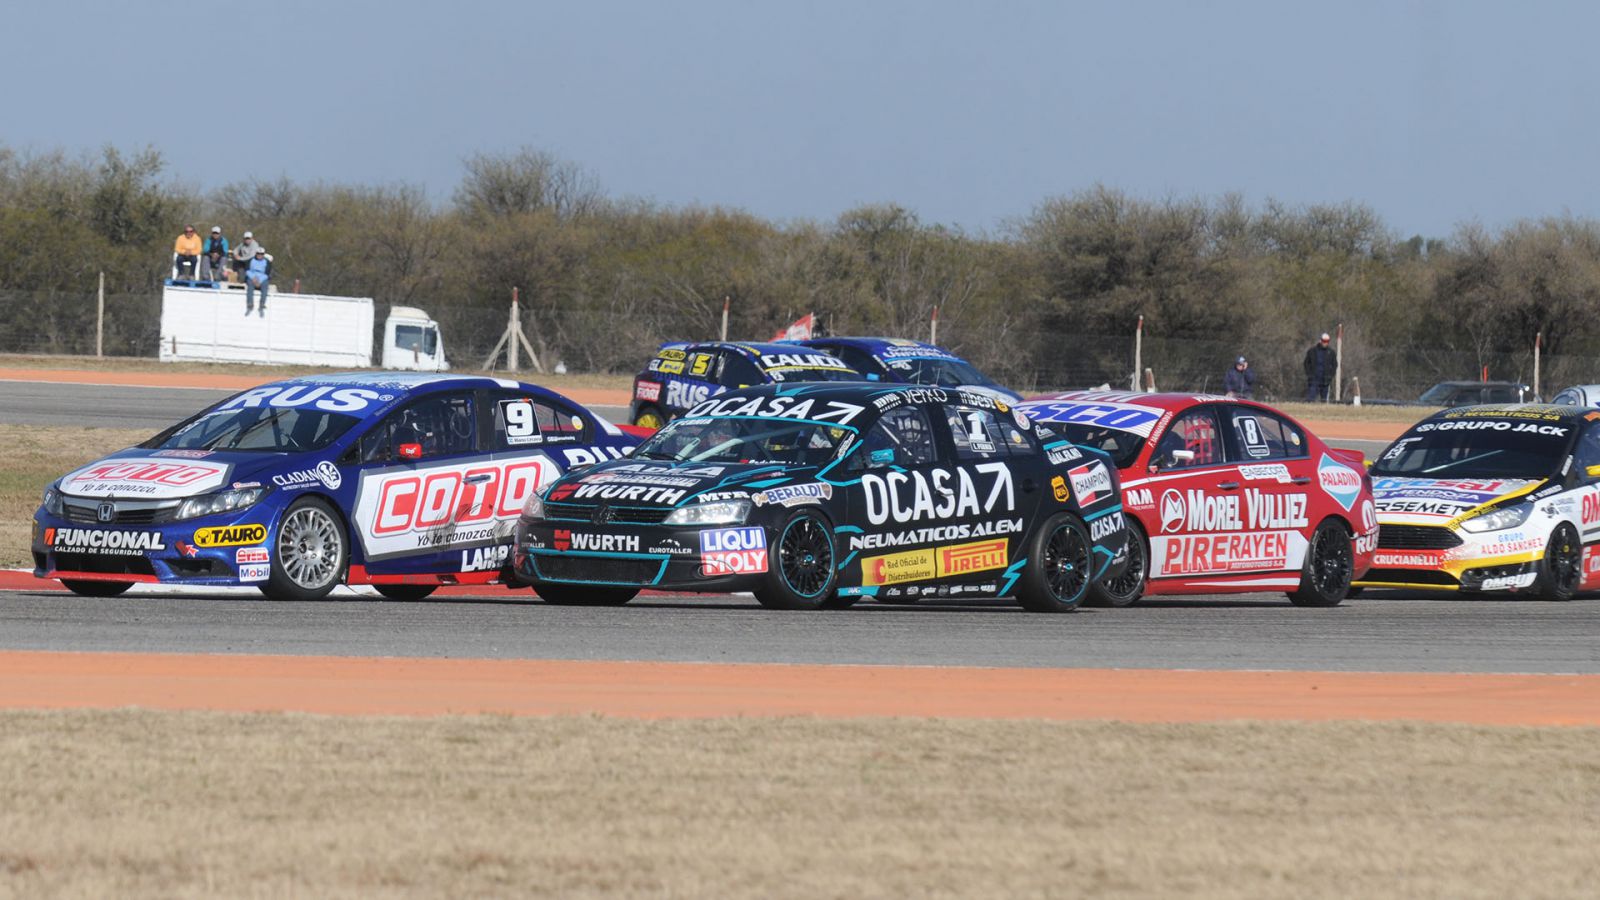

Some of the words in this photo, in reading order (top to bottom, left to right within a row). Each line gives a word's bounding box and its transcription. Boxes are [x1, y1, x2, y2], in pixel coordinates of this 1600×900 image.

[692, 354, 710, 374] 5
[761, 354, 847, 369] CALICO
[218, 386, 379, 411] RUS
[666, 380, 709, 409] RUS
[506, 402, 534, 436] 9
[967, 412, 986, 442] 1
[1440, 421, 1511, 431] GRUPO
[1512, 424, 1569, 437] JACK
[1244, 418, 1258, 444] 8
[71, 462, 220, 487] COTO
[273, 468, 320, 486] CLADAN
[1076, 471, 1108, 494] CHAMPION
[1322, 472, 1360, 488] PALADINI
[80, 484, 93, 493] Yo
[373, 461, 542, 534] COTO
[574, 484, 687, 505] WÜRTH
[765, 484, 823, 503] BERALDI
[1187, 489, 1243, 531] MOREL
[1244, 488, 1309, 529] VULLIEZ
[55, 528, 165, 550] FUNCIONAL
[211, 527, 264, 543] TAURO
[418, 535, 429, 546] Yo
[432, 534, 443, 544] te
[570, 533, 640, 551] WÜRTH
[704, 530, 764, 551] LIQUI
[850, 523, 971, 550] NEUMATICOS
[971, 518, 1023, 537] ALEM
[1498, 533, 1524, 542] GRUPO
[648, 546, 692, 554] EUROTALLER
[1229, 533, 1288, 559] RAYEN
[1481, 543, 1506, 554] ALDO
[1507, 538, 1544, 552] SANCHEZ
[705, 551, 766, 573] MOLY
[887, 559, 899, 569] Red
[900, 556, 919, 567] Oficial
[920, 556, 927, 564] de
[943, 541, 1006, 574] PIRELLI
[1374, 554, 1438, 565] CRUCIANELLI
[241, 567, 269, 578] Mobil
[888, 570, 930, 582] Distribuidores
